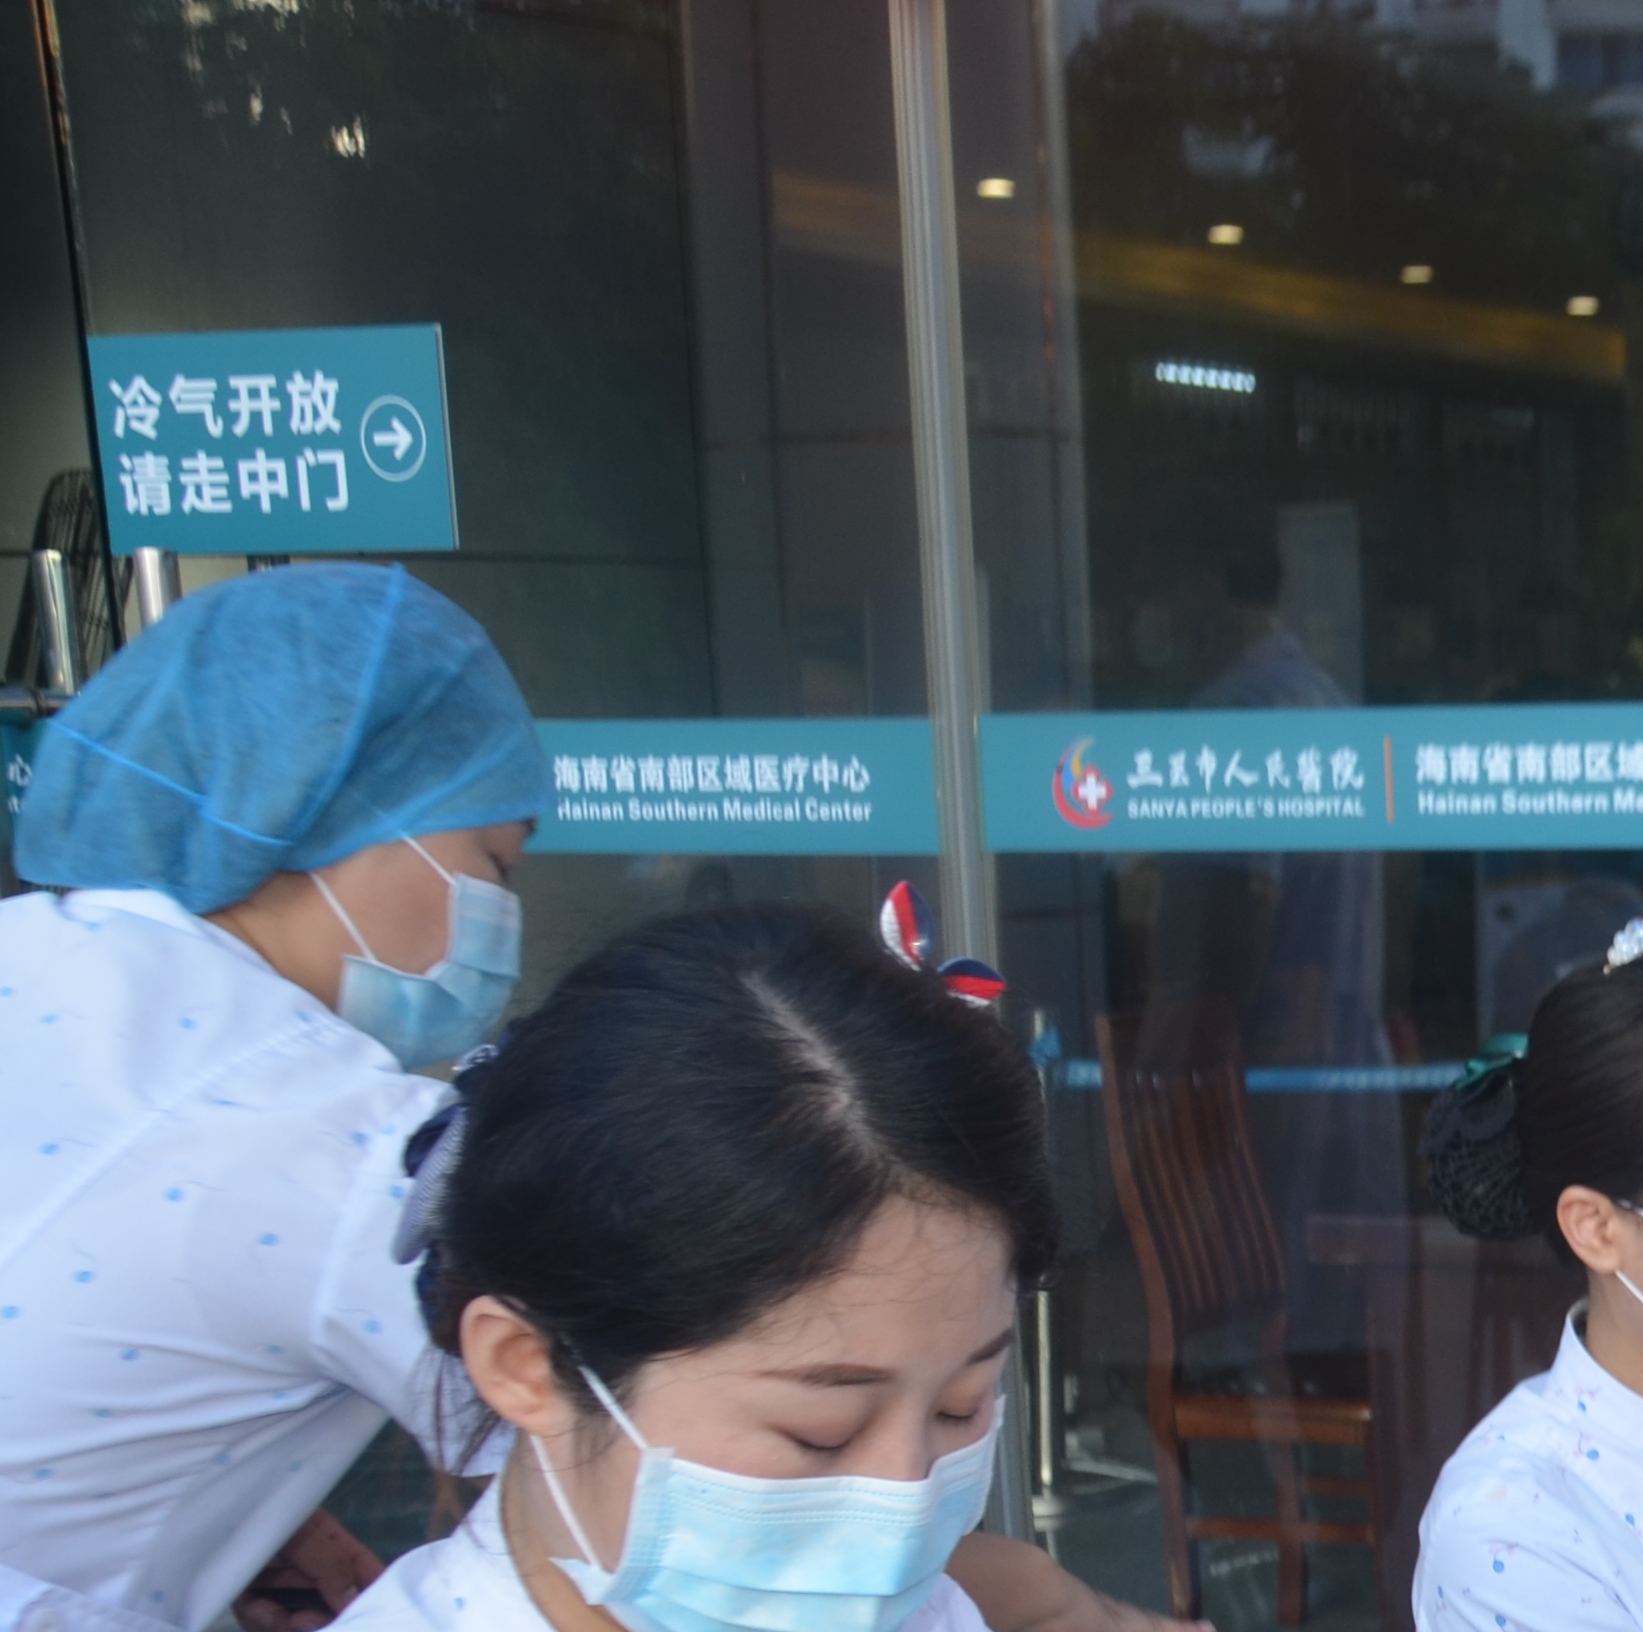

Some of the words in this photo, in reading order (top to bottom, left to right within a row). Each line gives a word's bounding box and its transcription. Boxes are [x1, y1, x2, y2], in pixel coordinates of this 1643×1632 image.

[109, 368, 341, 440] 冷气开放
[118, 446, 349, 516] 请走中门
[553, 753, 870, 794] 海南省南部区域医疗中心
[558, 798, 624, 822] Hainan
[628, 798, 719, 822] Southern
[722, 798, 800, 822] Medical
[804, 797, 872, 822] Center
[1126, 797, 1188, 820] SANYA
[1190, 796, 1275, 819] PEOPLE'S
[1278, 796, 1365, 818] HOSPITAL
[1417, 791, 1497, 816] Hainan
[1501, 790, 1609, 815] Southern
